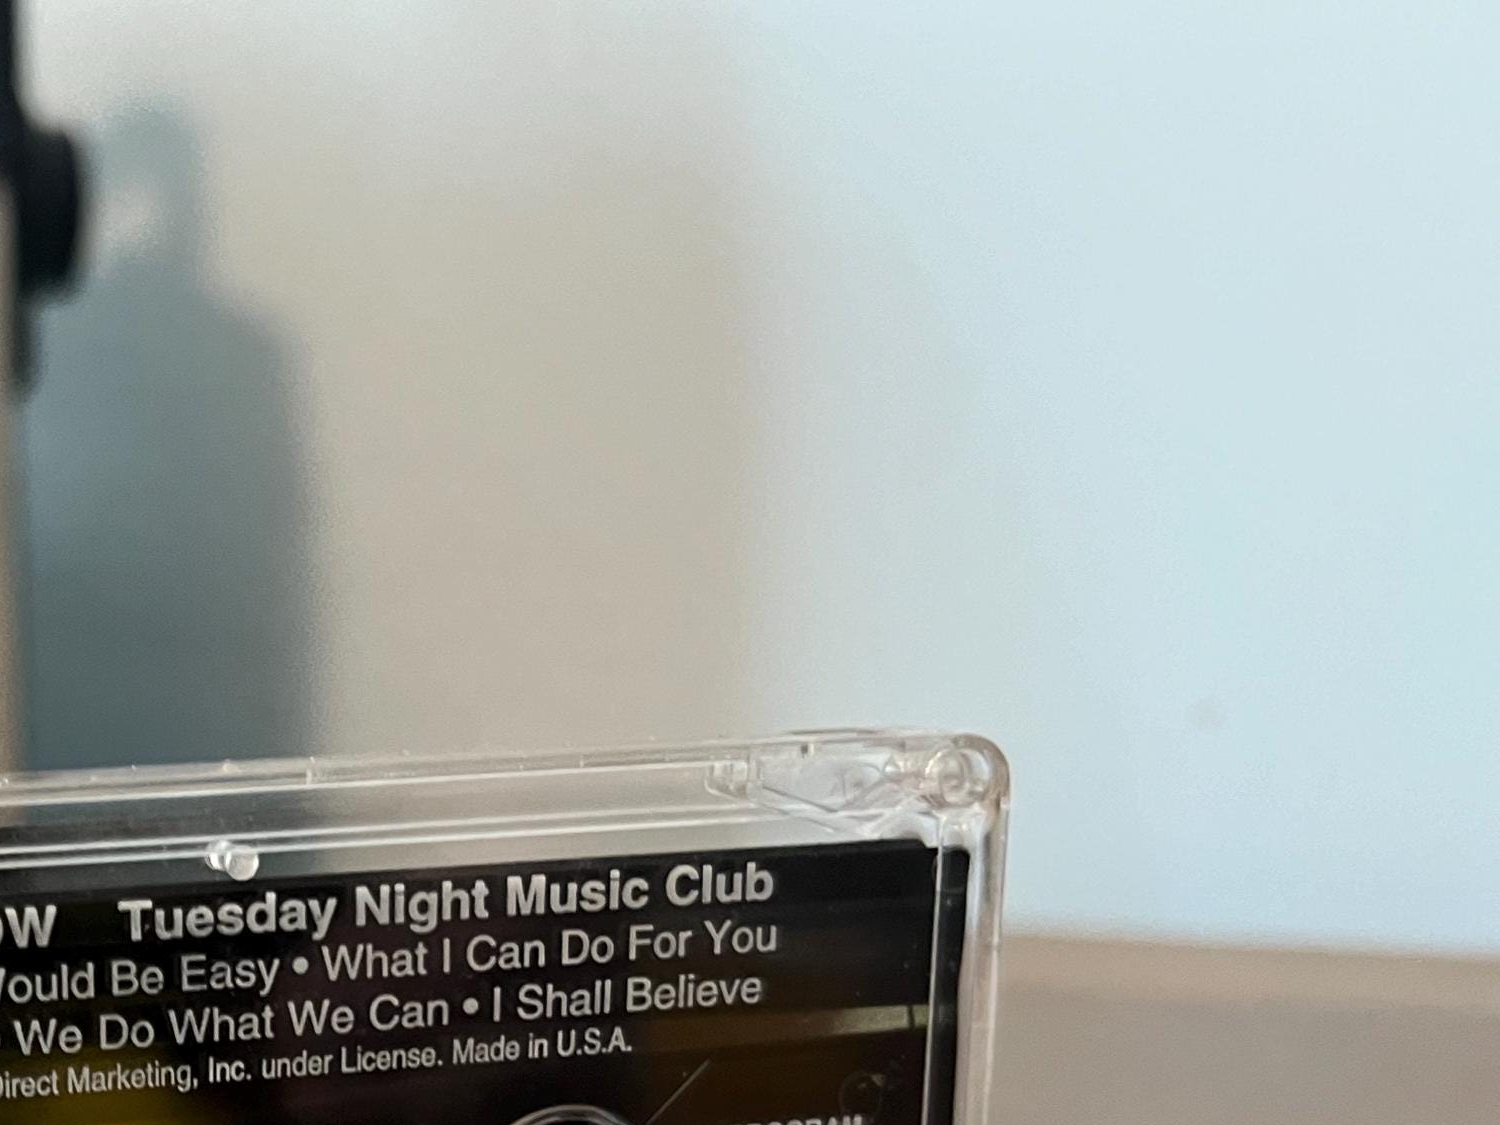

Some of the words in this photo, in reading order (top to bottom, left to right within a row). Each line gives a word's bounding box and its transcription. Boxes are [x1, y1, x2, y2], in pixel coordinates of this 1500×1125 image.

[118, 892, 336, 942] Tuesday
[355, 881, 489, 932] Night
[506, 871, 648, 916] Music
[665, 862, 774, 904] Club
[111, 959, 163, 996] Be
[181, 953, 280, 997] Easy
[321, 942, 427, 982] What
[443, 938, 450, 974] I
[465, 935, 546, 971] Can
[561, 929, 614, 966] Do
[629, 924, 692, 960] For
[704, 920, 778, 955] You
[15, 1018, 82, 1057] We
[99, 1014, 154, 1050] Do
[169, 1004, 274, 1045] What
[287, 998, 354, 1036] We
[368, 994, 448, 1031] Can
[493, 986, 500, 1022] I
[517, 979, 611, 1019] Shall
[626, 975, 763, 1012] Believe
[67, 1057, 198, 1094] Marketing,
[208, 1057, 251, 1084] Inc.
[261, 1049, 332, 1079] under
[341, 1042, 443, 1073] License.
[453, 1035, 520, 1066] Made
[528, 1032, 548, 1058] in
[556, 1027, 631, 1055] U.S.A.
